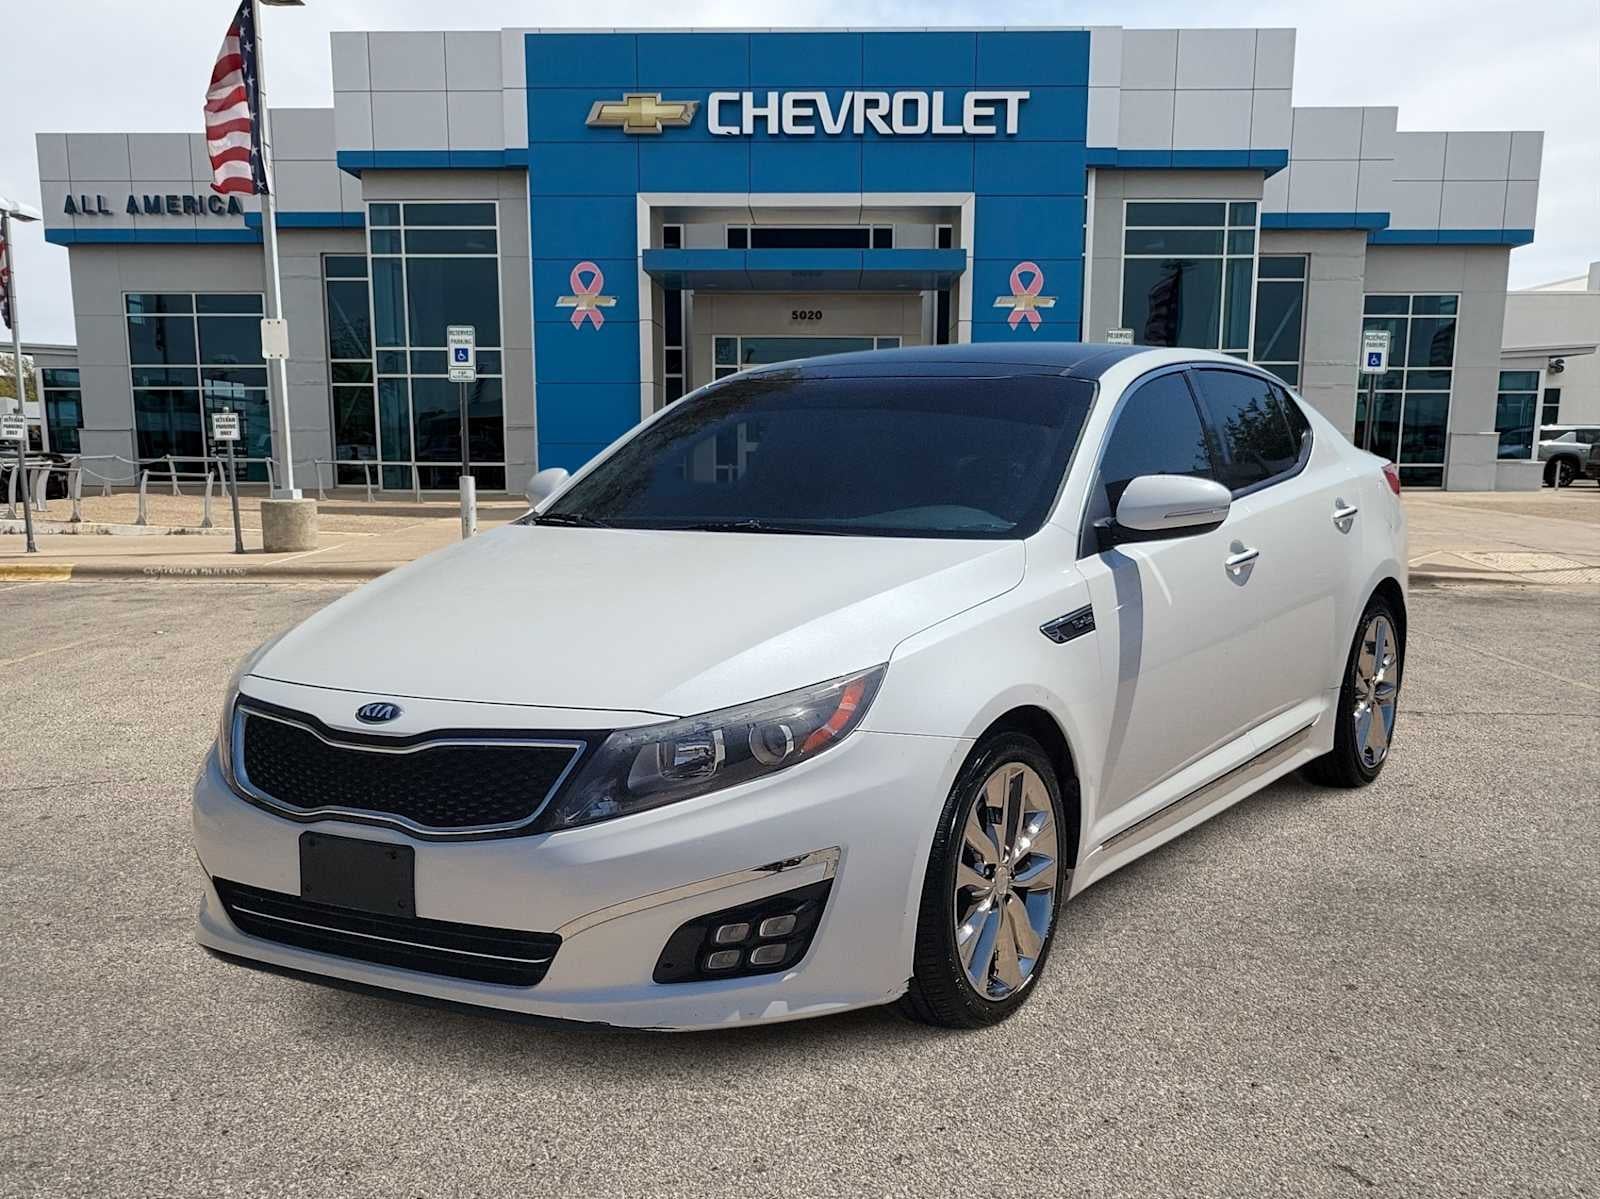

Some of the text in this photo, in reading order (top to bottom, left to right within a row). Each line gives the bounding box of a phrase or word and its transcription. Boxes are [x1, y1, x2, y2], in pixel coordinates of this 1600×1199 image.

[707, 90, 1031, 136] CHEVROLET
[64, 194, 243, 215] ALL AMERICA
[791, 310, 823, 320] 5020
[360, 703, 394, 719] KIA
